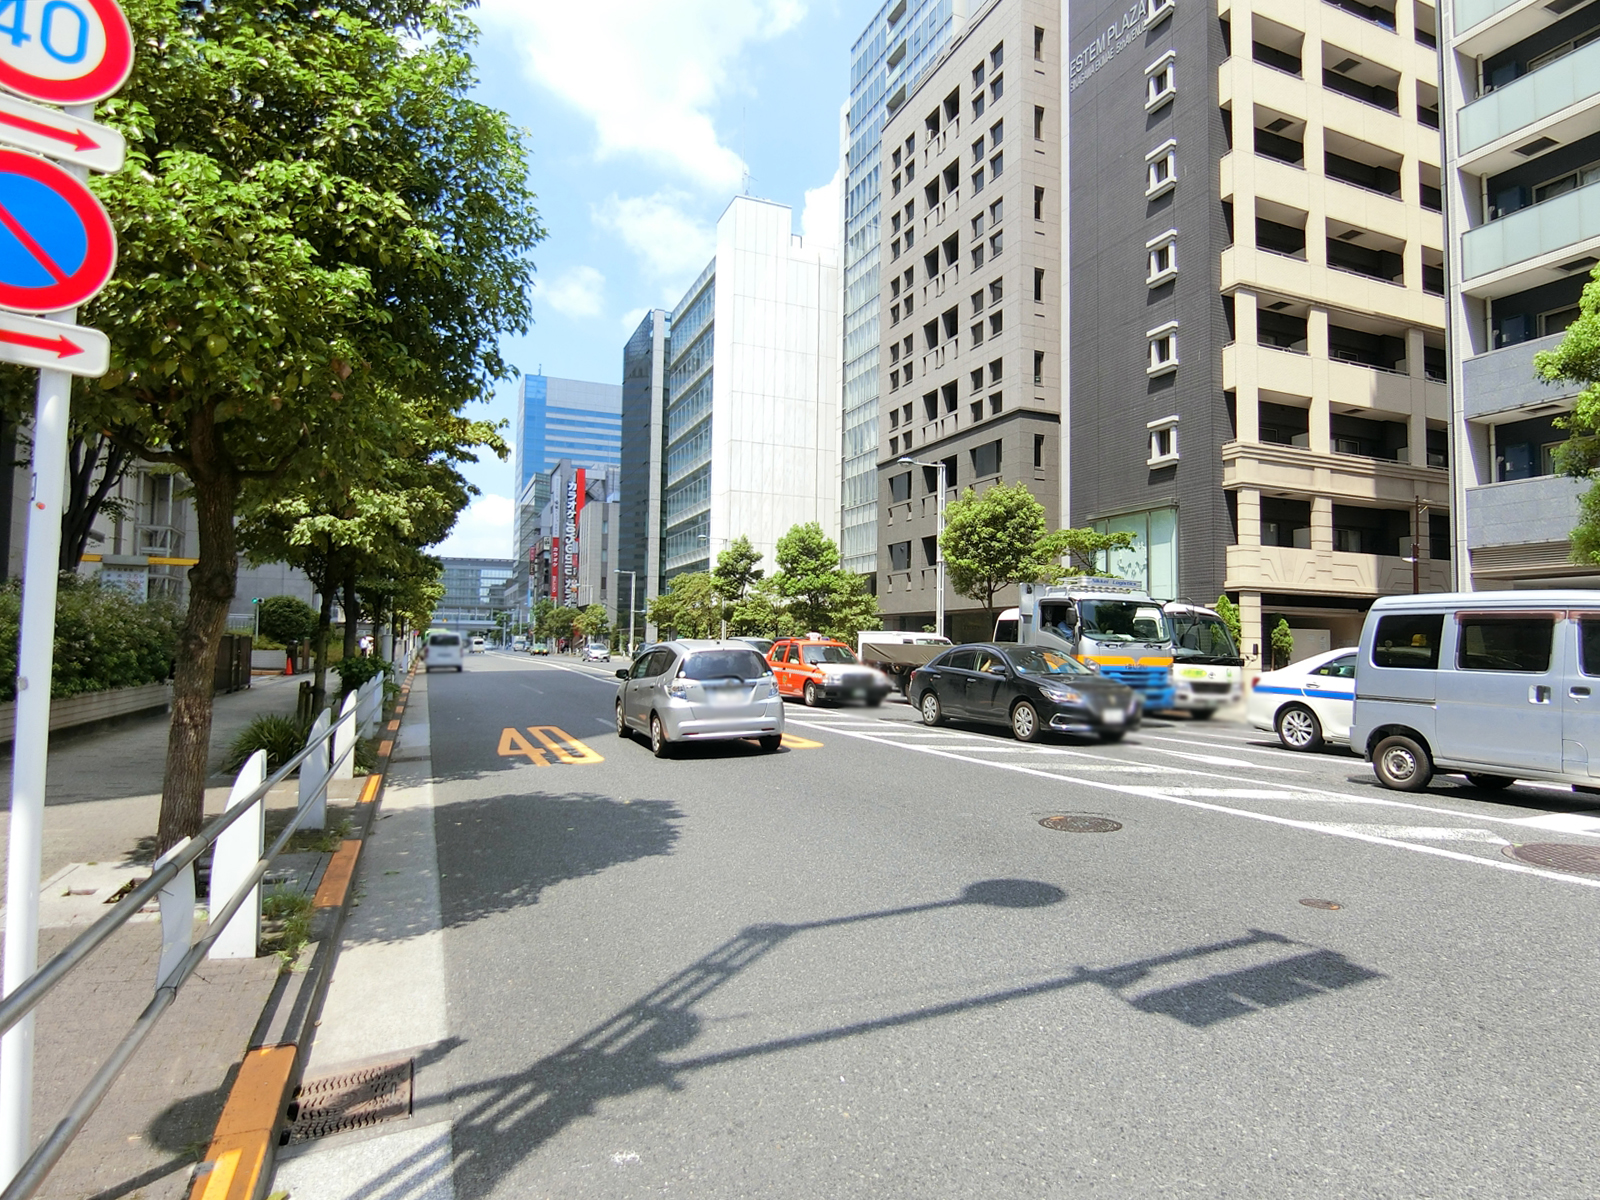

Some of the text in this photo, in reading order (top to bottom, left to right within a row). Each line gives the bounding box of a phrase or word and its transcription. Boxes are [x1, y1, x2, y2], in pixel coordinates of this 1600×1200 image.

[0, 0, 90, 64] 40
[1070, 0, 1147, 80] ESTEM PLAZA
[497, 725, 605, 767] 40
